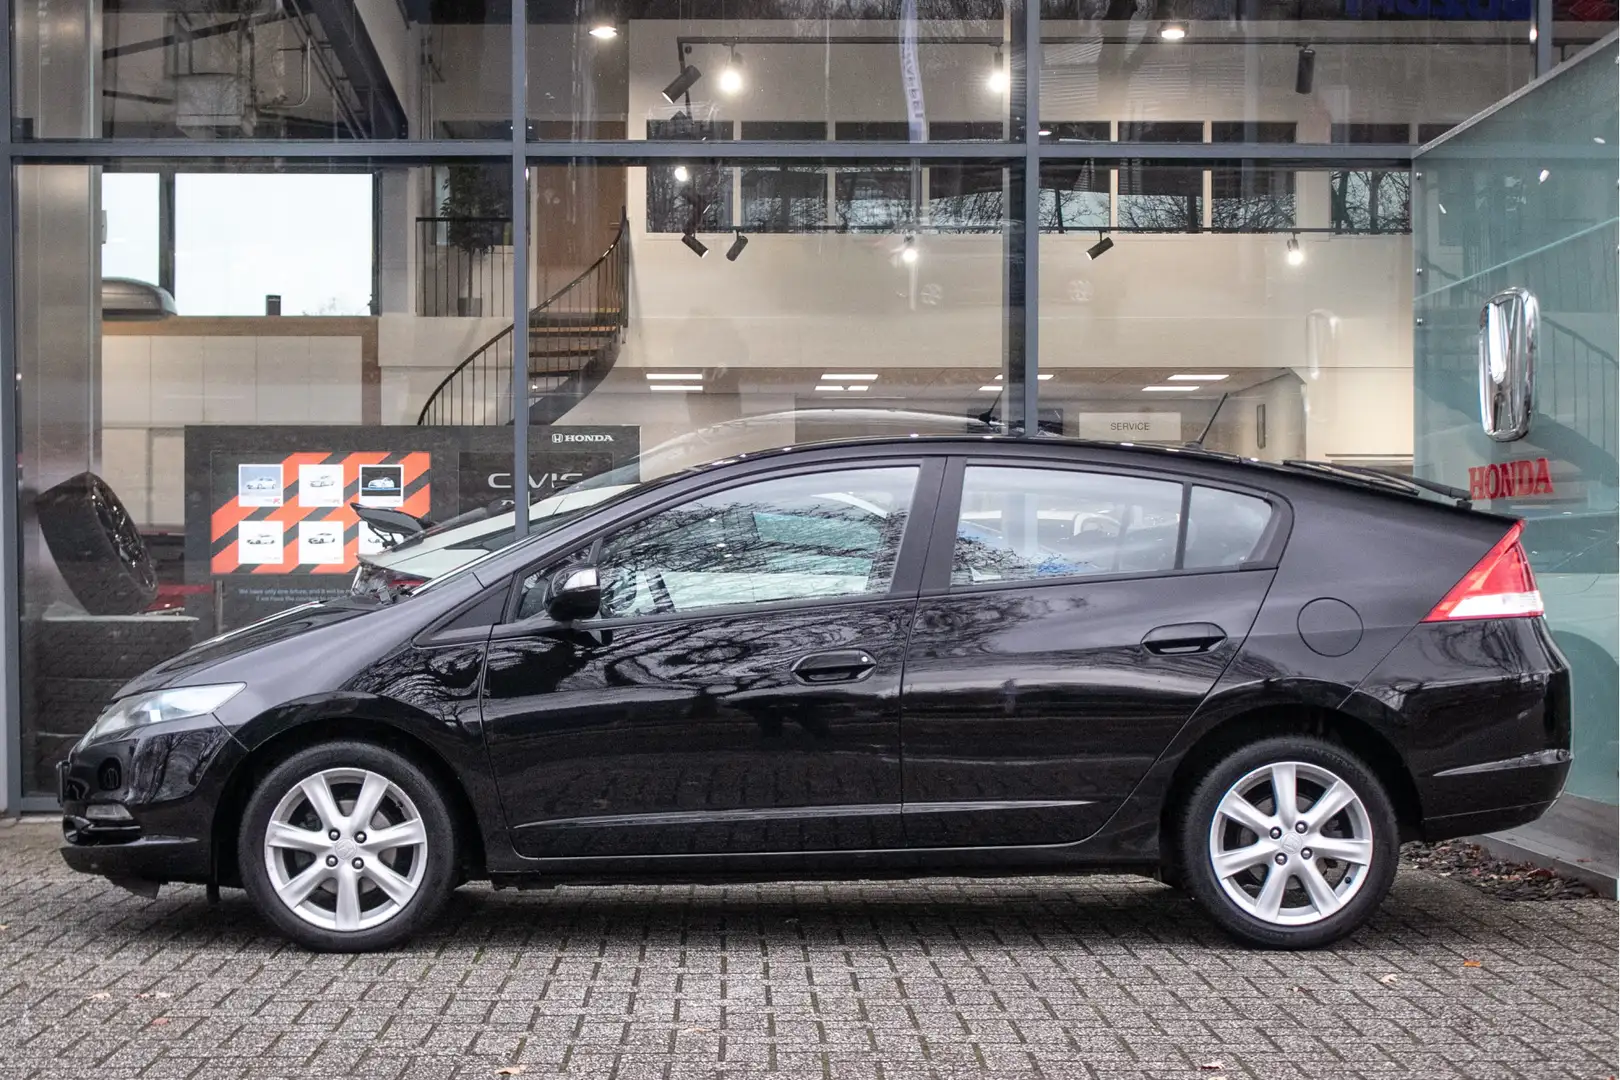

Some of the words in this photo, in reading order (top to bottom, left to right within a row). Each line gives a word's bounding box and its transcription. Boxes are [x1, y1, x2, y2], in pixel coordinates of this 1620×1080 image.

[1110, 422, 1151, 431] SERVICE
[565, 434, 614, 442] HONDA
[488, 473, 583, 489] CVI
[1468, 457, 1554, 500] HONDA
